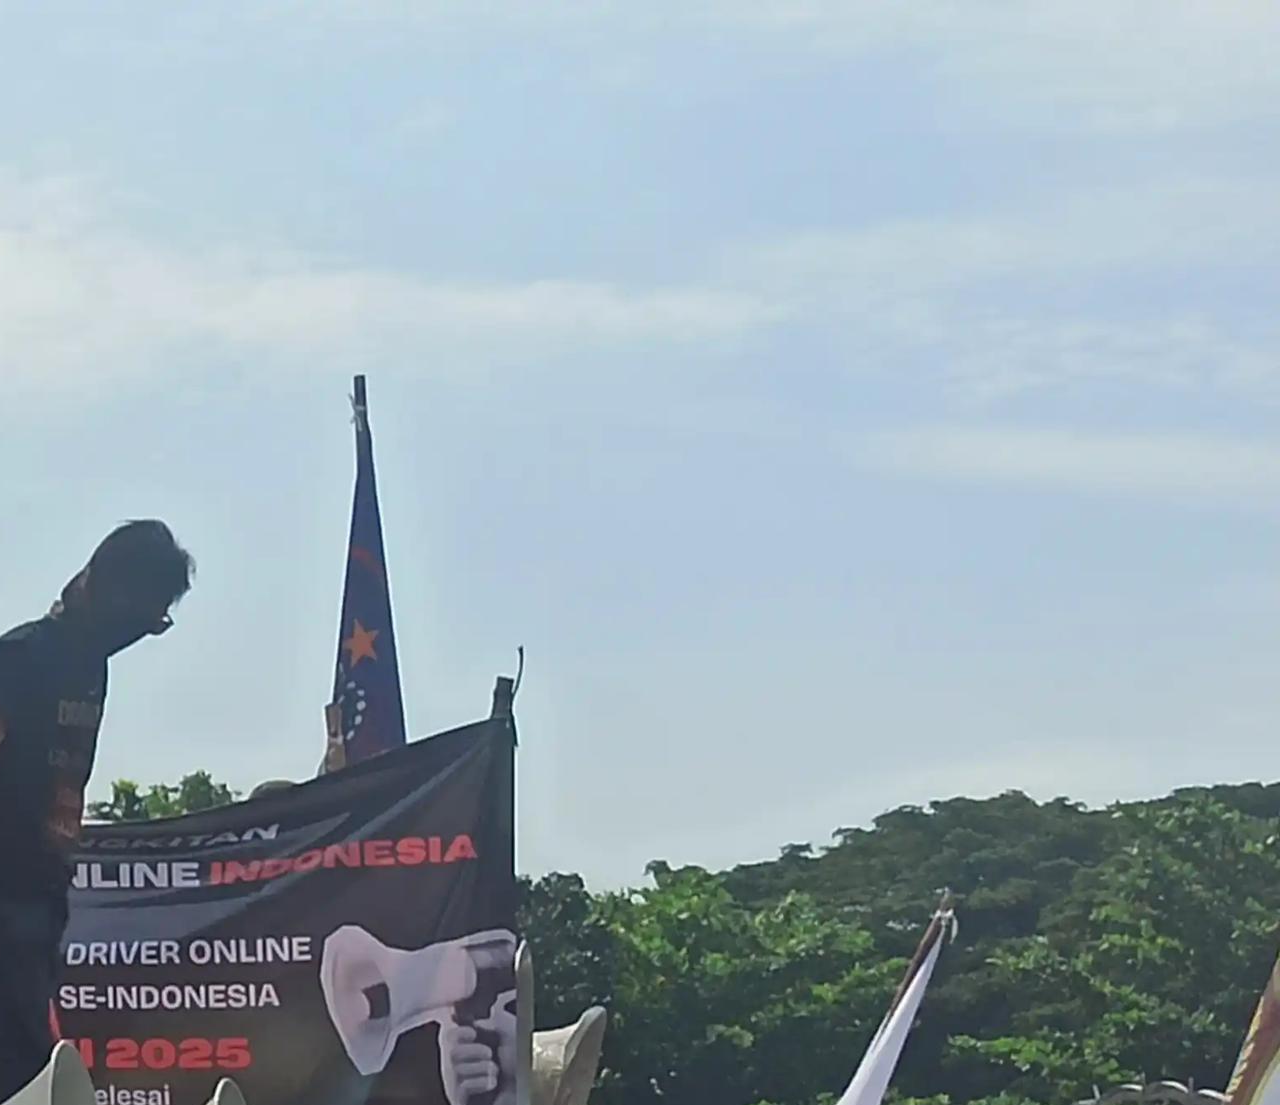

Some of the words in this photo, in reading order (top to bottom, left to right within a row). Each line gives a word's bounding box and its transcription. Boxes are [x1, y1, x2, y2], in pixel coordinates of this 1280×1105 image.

[208, 834, 478, 886] INDONESIA
[66, 940, 181, 966] DRIVER
[189, 936, 312, 964] ONLINE
[59, 983, 280, 1010] SE-INDONESIA
[105, 1037, 252, 1070] 2025
